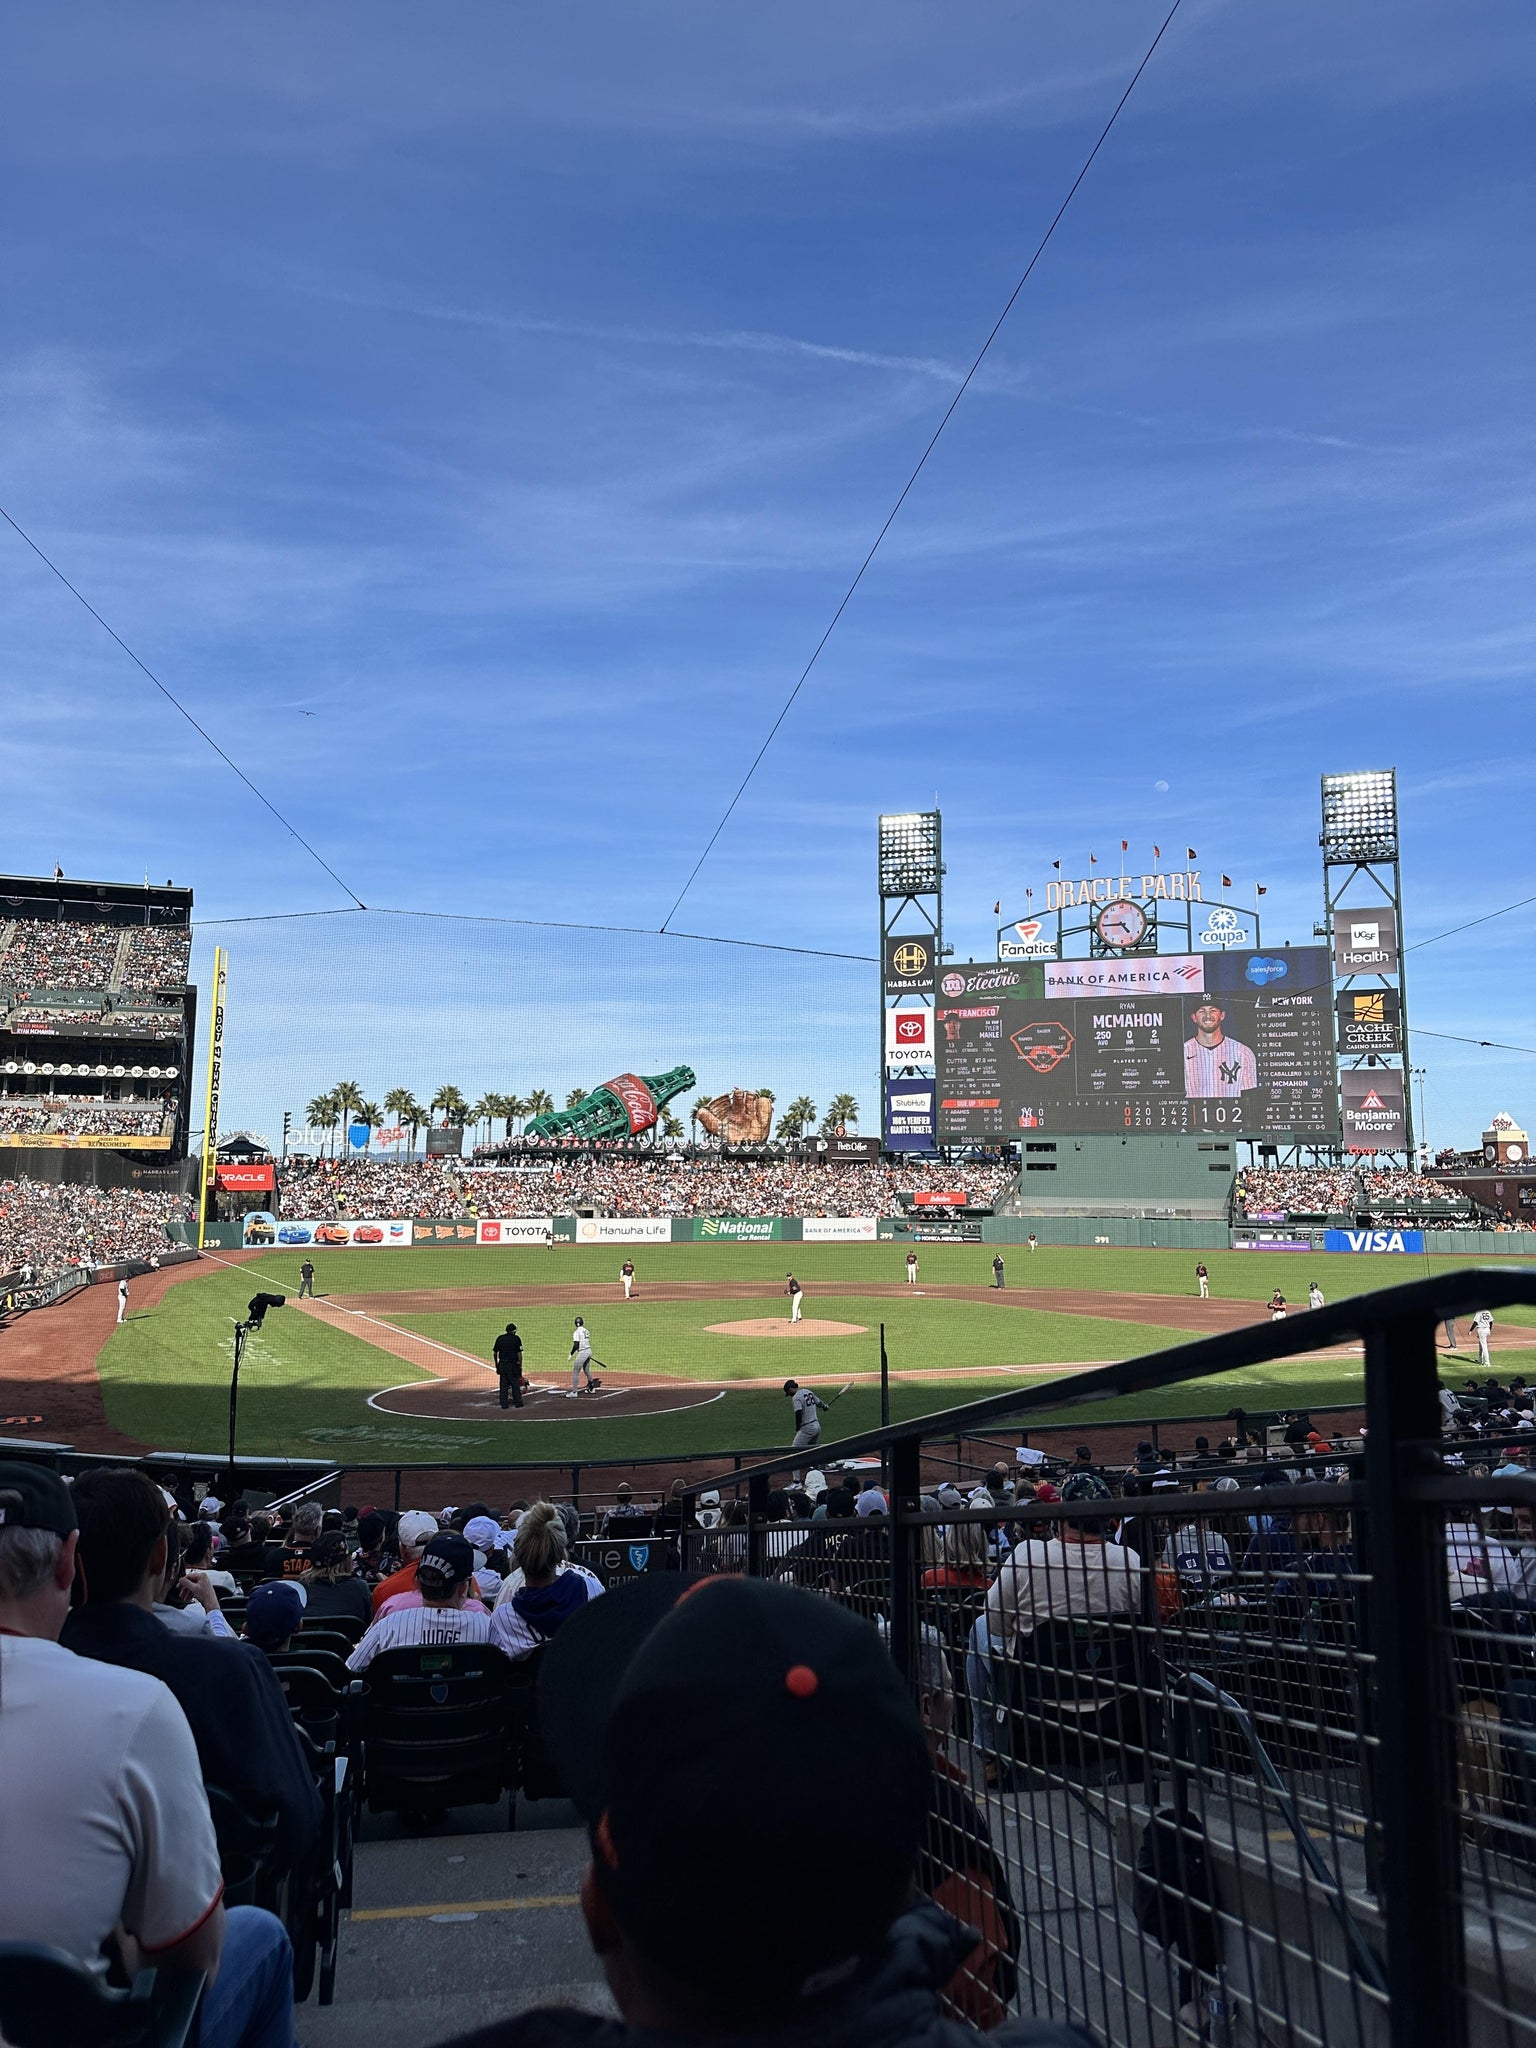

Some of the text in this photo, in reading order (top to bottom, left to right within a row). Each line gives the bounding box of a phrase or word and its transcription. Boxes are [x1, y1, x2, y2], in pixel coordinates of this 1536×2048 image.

[1046, 871, 1203, 911] ORACLE PARK
[1203, 930, 1244, 944] coupa
[1354, 931, 1376, 940] UCSF
[1001, 943, 1057, 956] Fanatics
[1344, 950, 1389, 963] Health
[1250, 965, 1284, 974] salesforce
[966, 972, 1020, 992] Electric
[1048, 972, 1170, 986] BANK OF AMERICA
[1290, 996, 1313, 1005] YORK
[960, 1008, 996, 1017] FRANCISCO
[1093, 1013, 1162, 1028] MCMAHON
[1346, 1024, 1394, 1033] CACHE
[1094, 1031, 1111, 1040] .250
[1347, 1033, 1392, 1042] CREEK
[888, 1050, 932, 1059] TOYOTA
[1124, 1107, 1131, 1116] 0
[1135, 1107, 1141, 1115] 2
[1146, 1107, 1150, 1115] 0
[1161, 1107, 1165, 1115] 1
[1181, 1107, 1187, 1115] 2
[1202, 1108, 1242, 1122] 1 0 2
[1346, 1110, 1400, 1122] Benjamin
[209, 1094, 218, 1147] CHIKIN
[1124, 1118, 1131, 1126] 0
[1146, 1118, 1151, 1126] 0
[1161, 1118, 1166, 1126] 2
[1182, 1118, 1188, 1126] 2
[890, 1126, 932, 1134] GIANTS TICKETS
[1354, 1121, 1393, 1130] Moore
[286, 1125, 344, 1146] blue
[851, 1142, 867, 1152] Coffee
[1348, 1144, 1376, 1154] Coors
[216, 1174, 265, 1182] ORACLE
[505, 1227, 548, 1236] TOYOTA
[600, 1226, 666, 1235] Hanwha Life
[719, 1221, 773, 1234] National
[203, 1239, 221, 1248] 339
[1342, 1232, 1406, 1252] VISA
[418, 1630, 461, 1645] JUDGE
